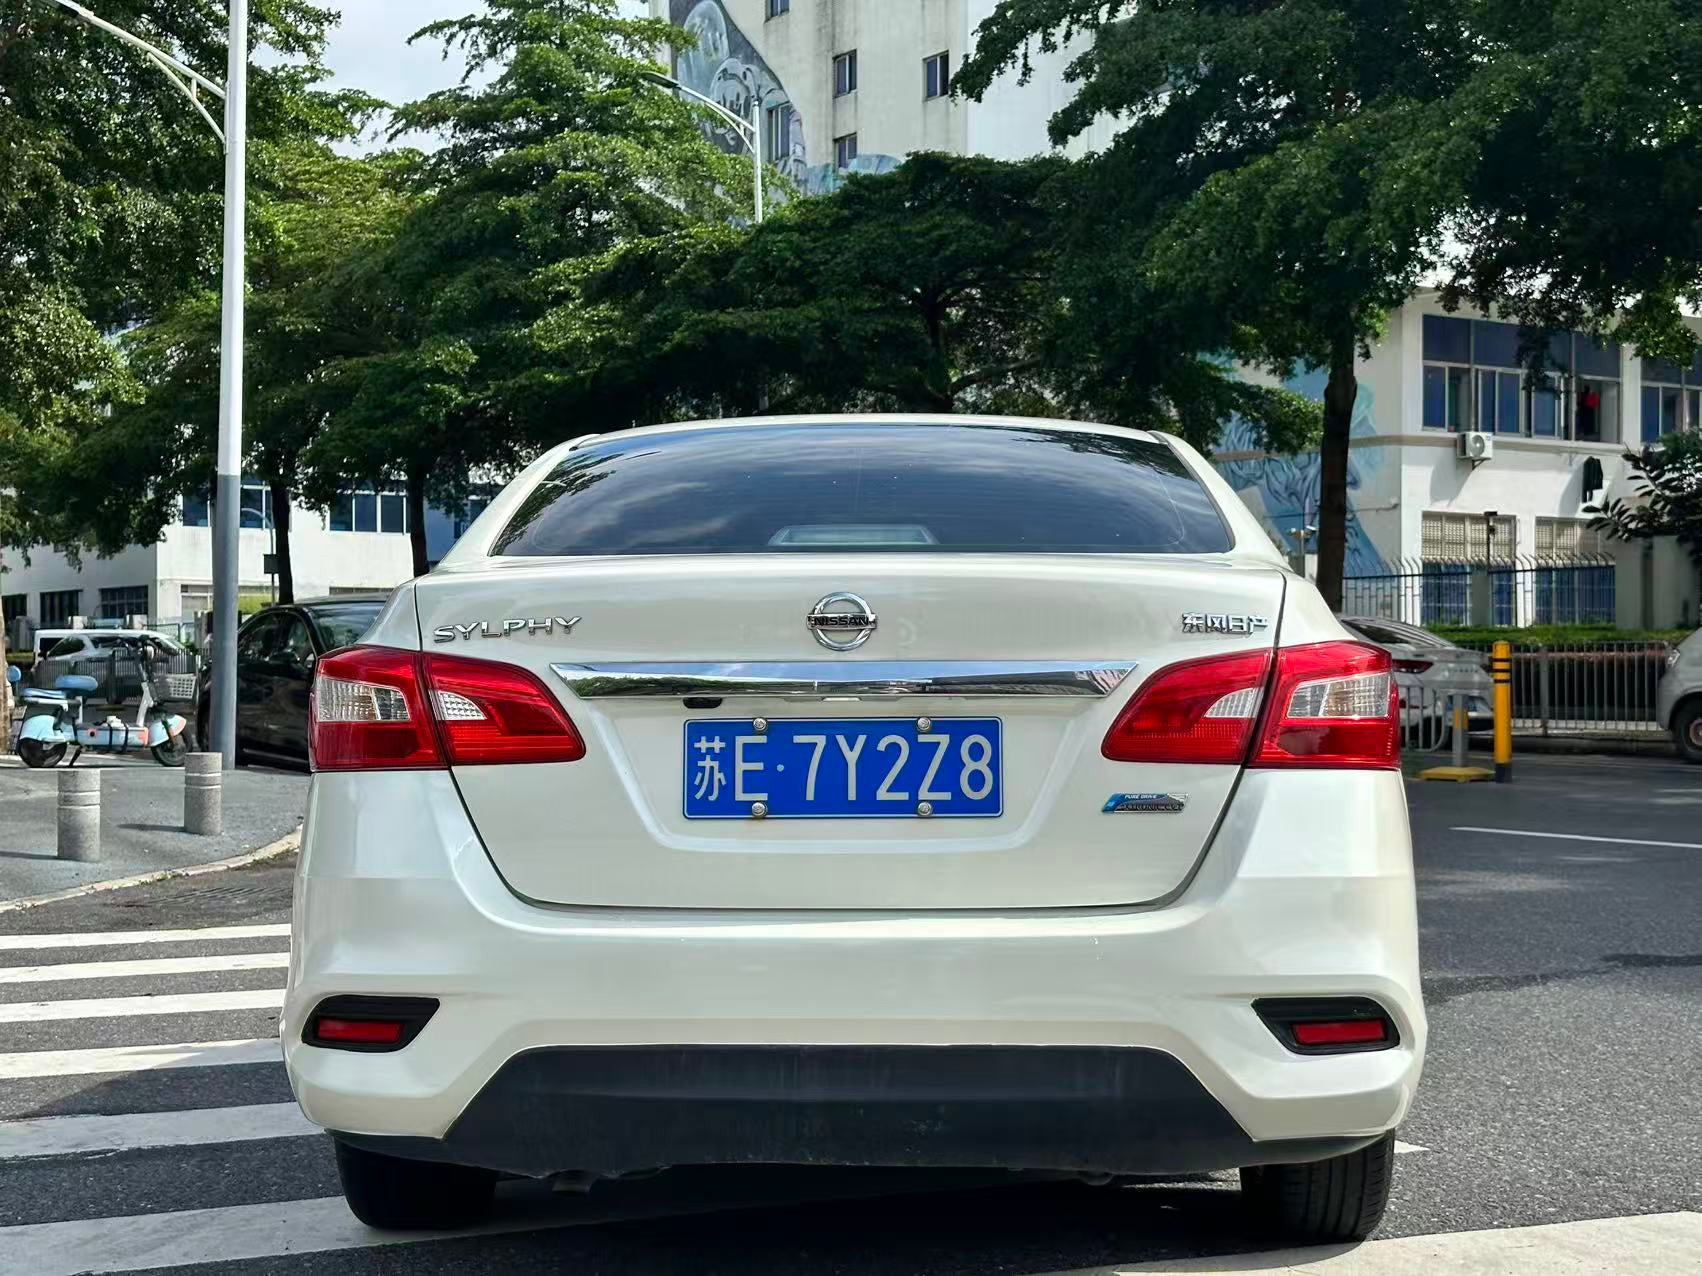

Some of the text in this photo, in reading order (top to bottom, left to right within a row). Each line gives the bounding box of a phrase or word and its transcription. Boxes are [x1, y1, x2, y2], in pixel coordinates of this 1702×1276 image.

[433, 616, 582, 643] SYLPHY
[814, 615, 869, 626] NISSAN
[1182, 612, 1268, 635] 东风日产
